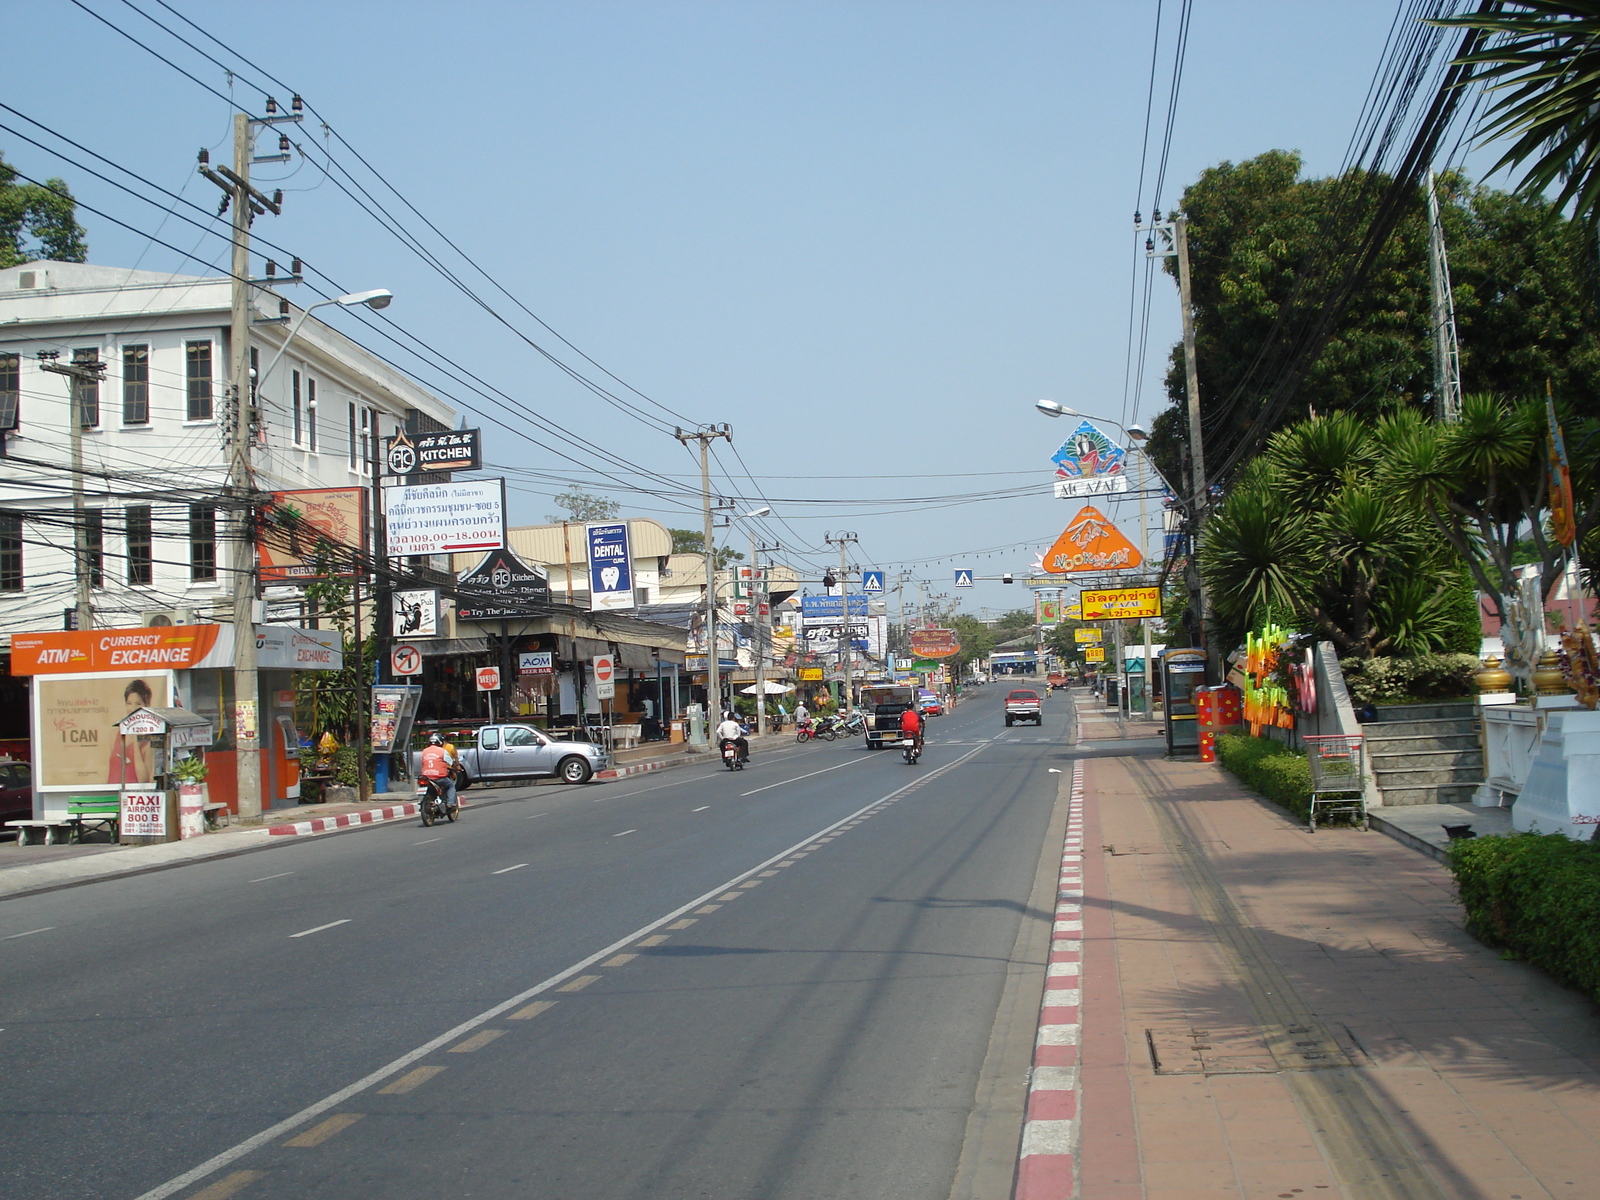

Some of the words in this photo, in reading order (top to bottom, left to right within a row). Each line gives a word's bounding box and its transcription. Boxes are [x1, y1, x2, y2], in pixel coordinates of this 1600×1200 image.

[420, 447, 471, 461] KITCHEN
[595, 544, 624, 557] DENTAL
[512, 573, 535, 582] Kitchen
[100, 635, 161, 650] CURRENCY
[291, 635, 318, 647] CURRENCY
[37, 649, 70, 664] ATM
[110, 647, 191, 664] EXCHANGE
[297, 649, 331, 662] EXCHANGE
[522, 657, 550, 666] AOM
[479, 674, 497, 686] หยุด
[123, 713, 161, 727] LIMOUSINE
[62, 730, 66, 743] I
[70, 729, 98, 743] CAN
[127, 795, 160, 806] TAXI
[128, 813, 148, 822] 800
[151, 813, 159, 822] B
